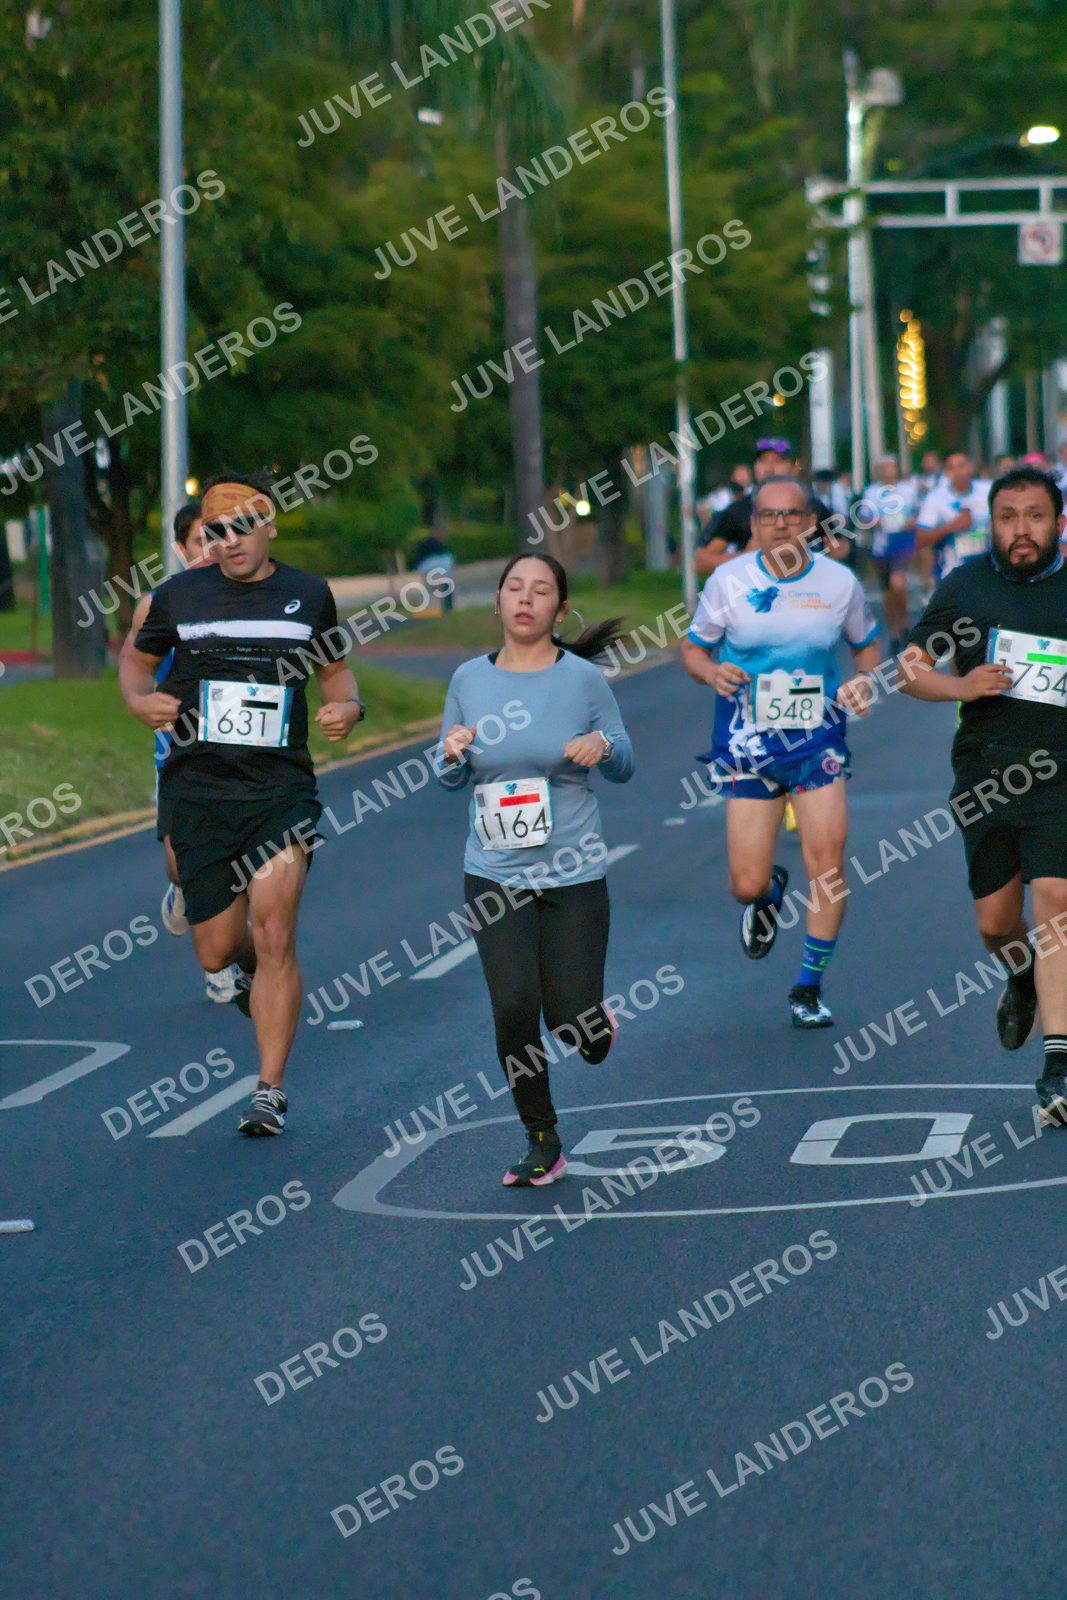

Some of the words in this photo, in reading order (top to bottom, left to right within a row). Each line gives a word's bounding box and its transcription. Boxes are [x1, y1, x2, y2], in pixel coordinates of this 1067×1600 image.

[217, 708, 266, 736] 631
[766, 698, 813, 721] 548
[480, 806, 550, 841] 1164
